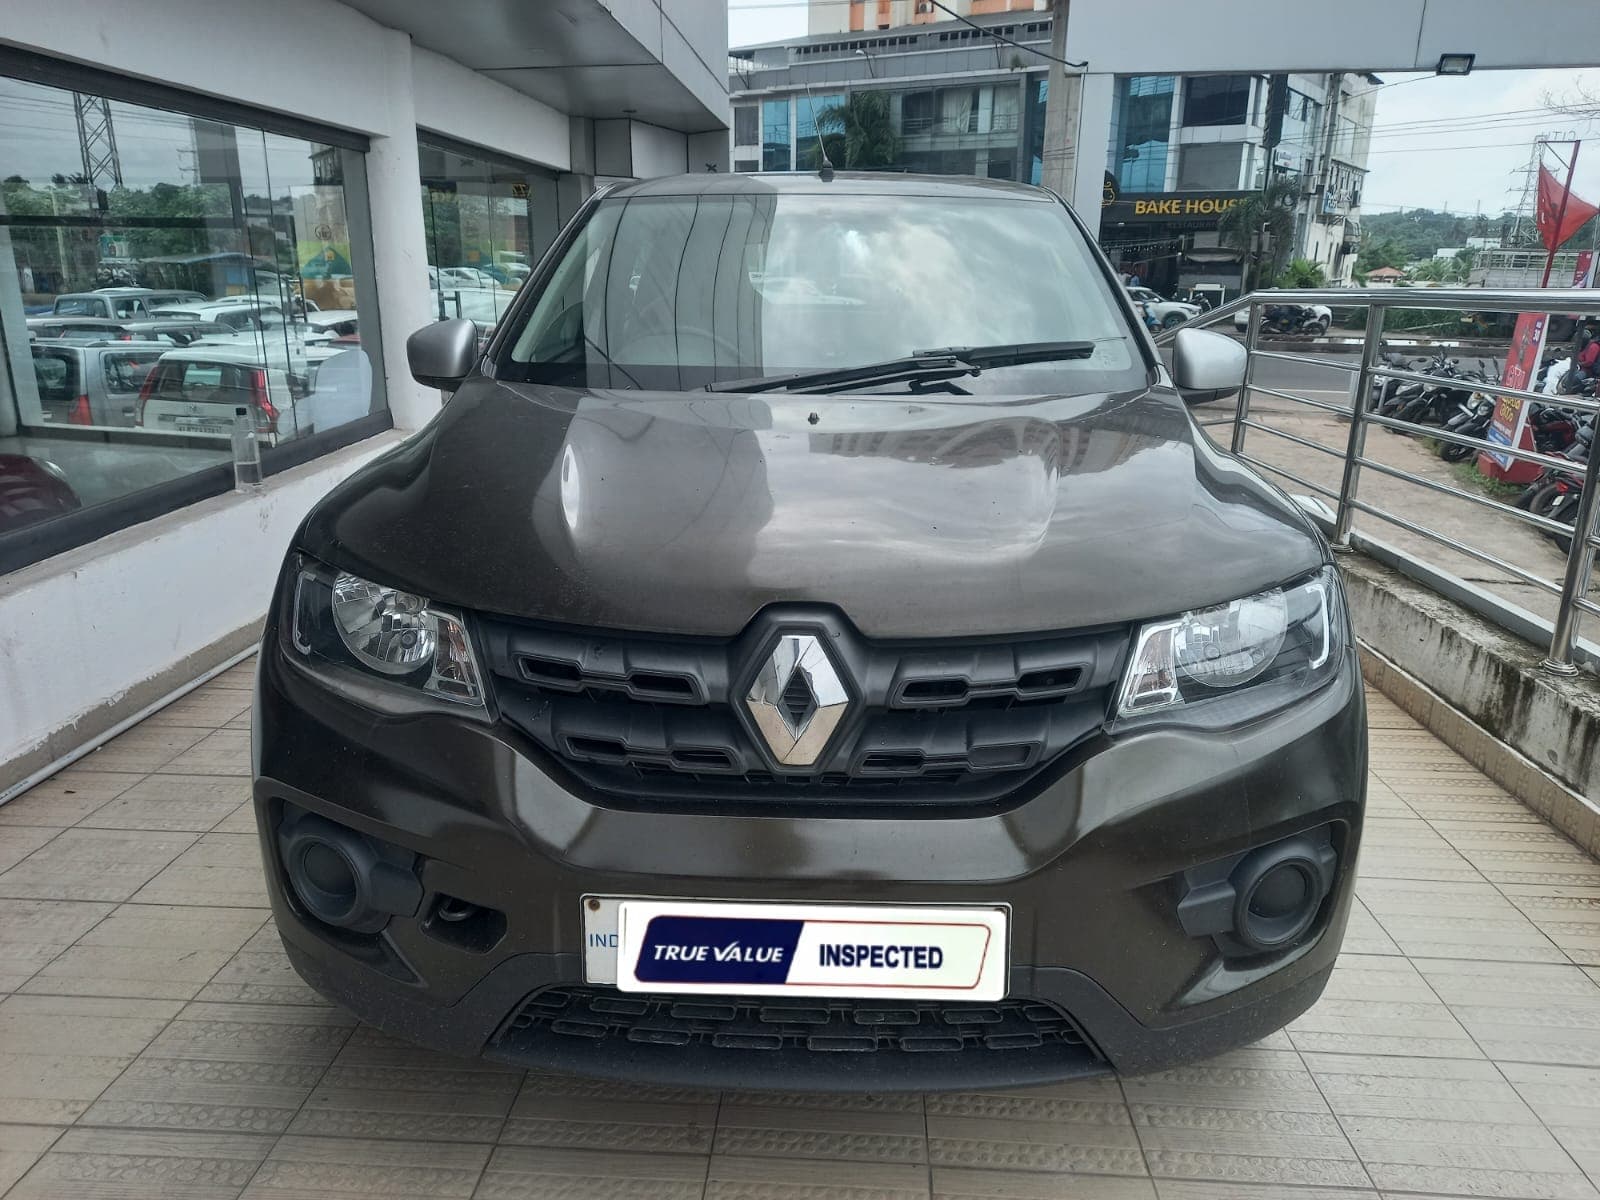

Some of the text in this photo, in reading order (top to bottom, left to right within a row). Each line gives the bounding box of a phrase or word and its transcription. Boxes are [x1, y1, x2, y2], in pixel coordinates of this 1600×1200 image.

[1135, 198, 1247, 215] BAKE HOUS
[589, 933, 619, 948] IND
